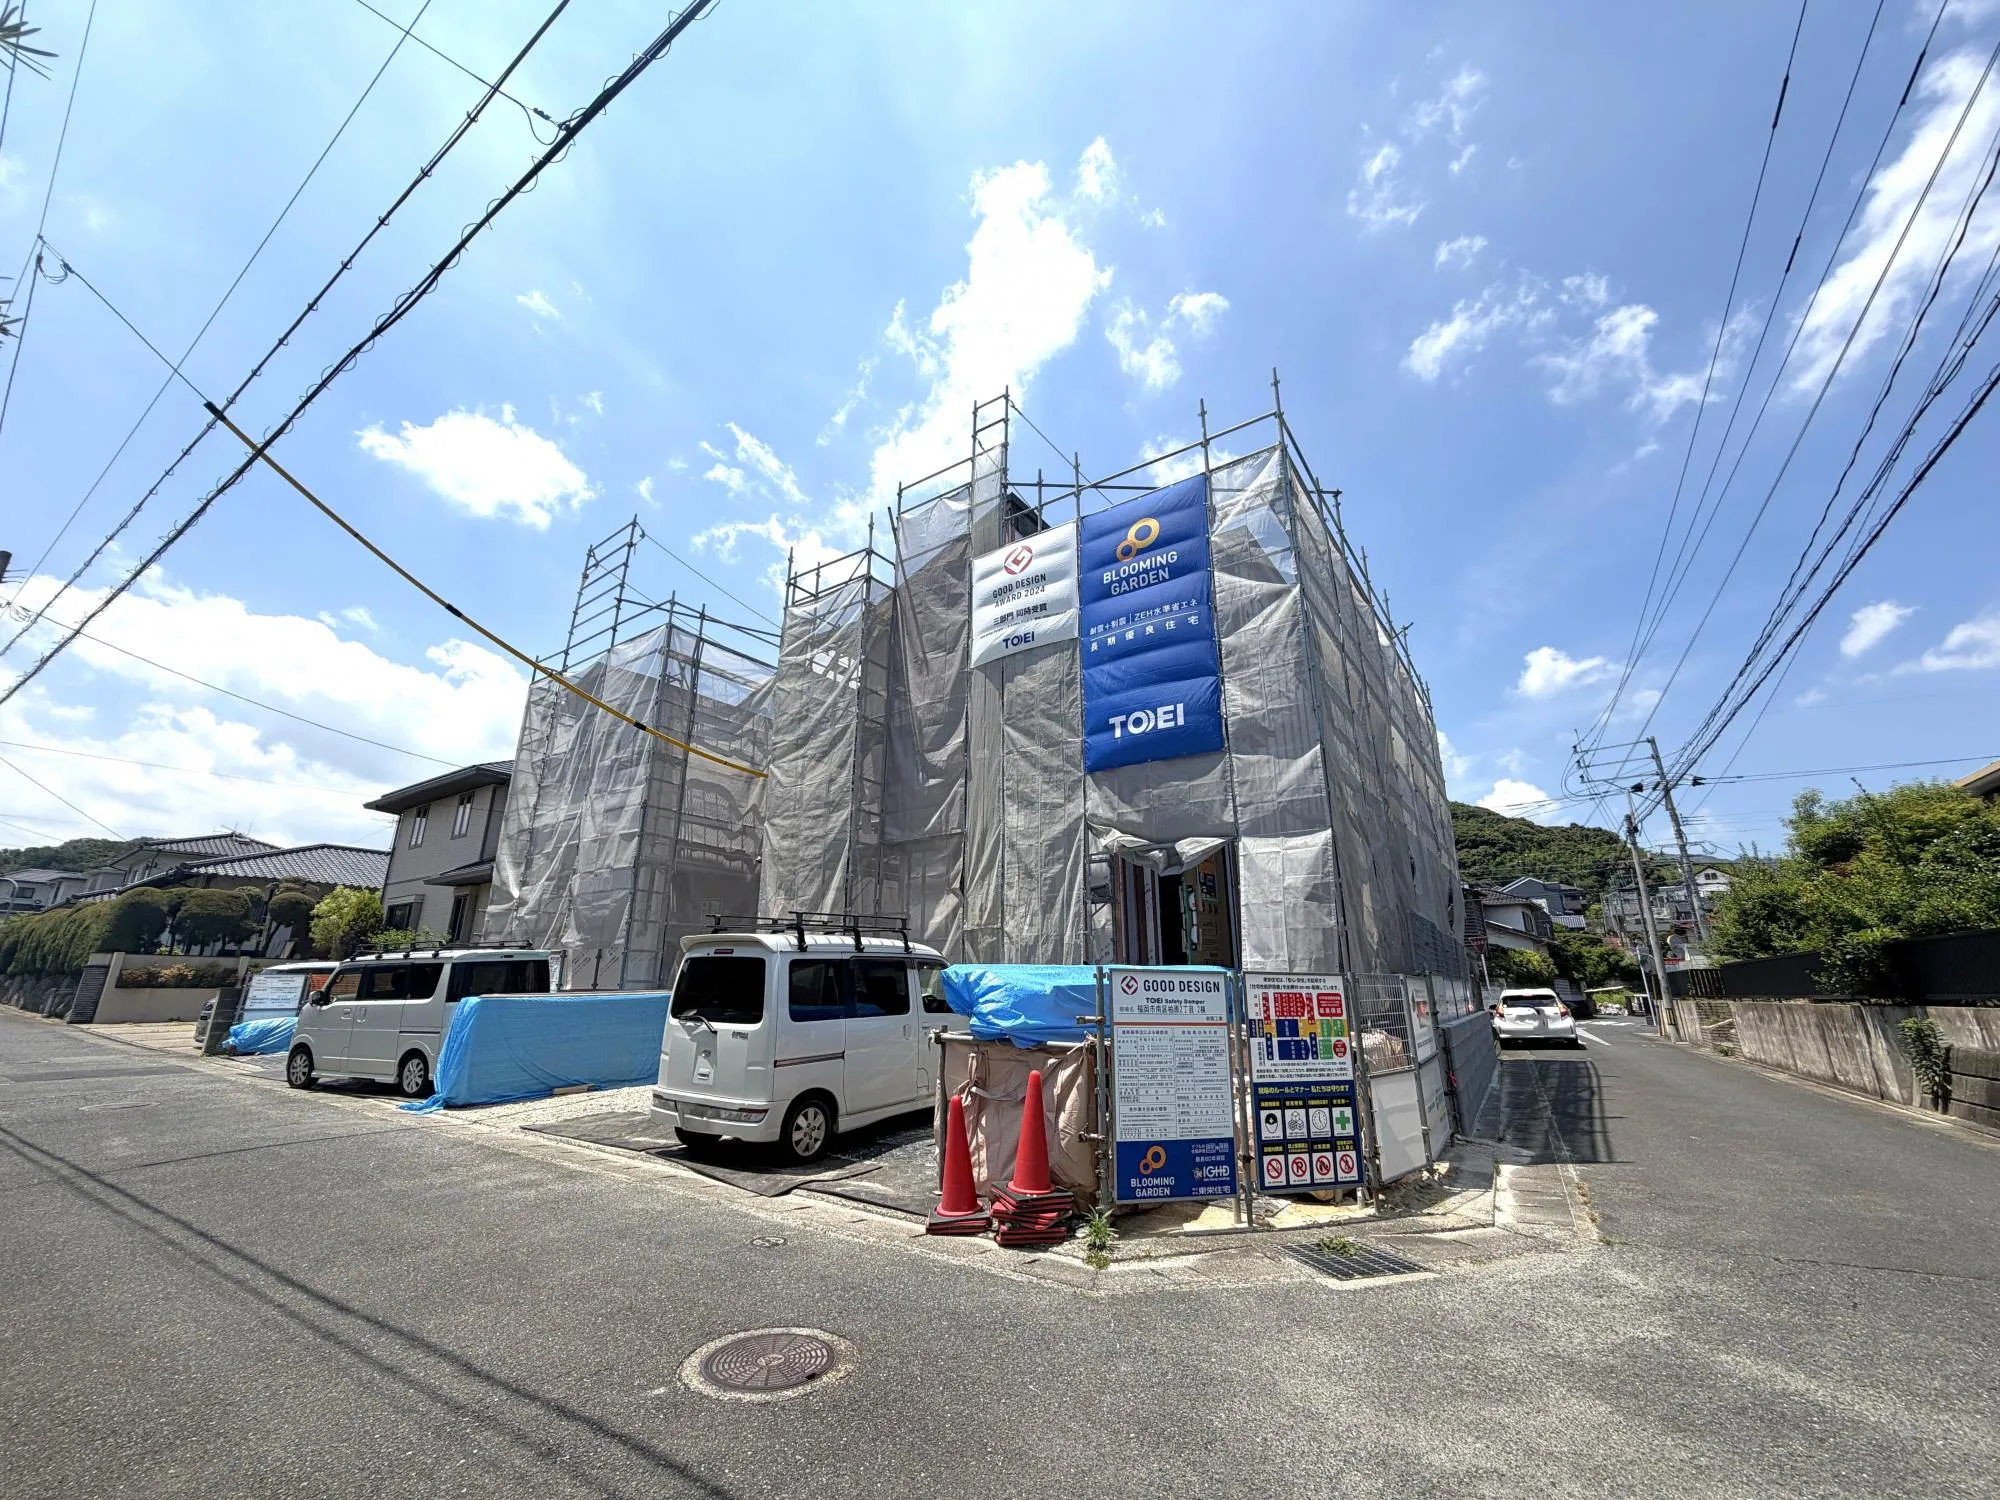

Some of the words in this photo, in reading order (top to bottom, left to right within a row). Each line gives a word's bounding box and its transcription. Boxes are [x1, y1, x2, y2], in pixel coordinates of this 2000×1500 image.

[1103, 551, 1178, 584] BLOOMING
[993, 584, 1014, 599] GOOD
[1015, 573, 1047, 589] DESIGN
[1111, 567, 1170, 595] GARDEN
[995, 592, 1022, 608] AWARD
[1024, 585, 1045, 597] 2024
[1134, 599, 1198, 621] ZEH水準省エネ
[993, 611, 1014, 626] 三部門
[1002, 631, 1035, 649] TOEI
[1108, 702, 1185, 739] TOEI
[1143, 980, 1175, 993] GOOD
[1179, 980, 1220, 993] DESIGN
[1164, 998, 1182, 1006] Safety
[1203, 1165, 1230, 1178] IGHD
[1130, 1176, 1175, 1188] BLOOMING
[1199, 1185, 1231, 1195] 東栄住宅
[1135, 1187, 1171, 1197] GARDEN
